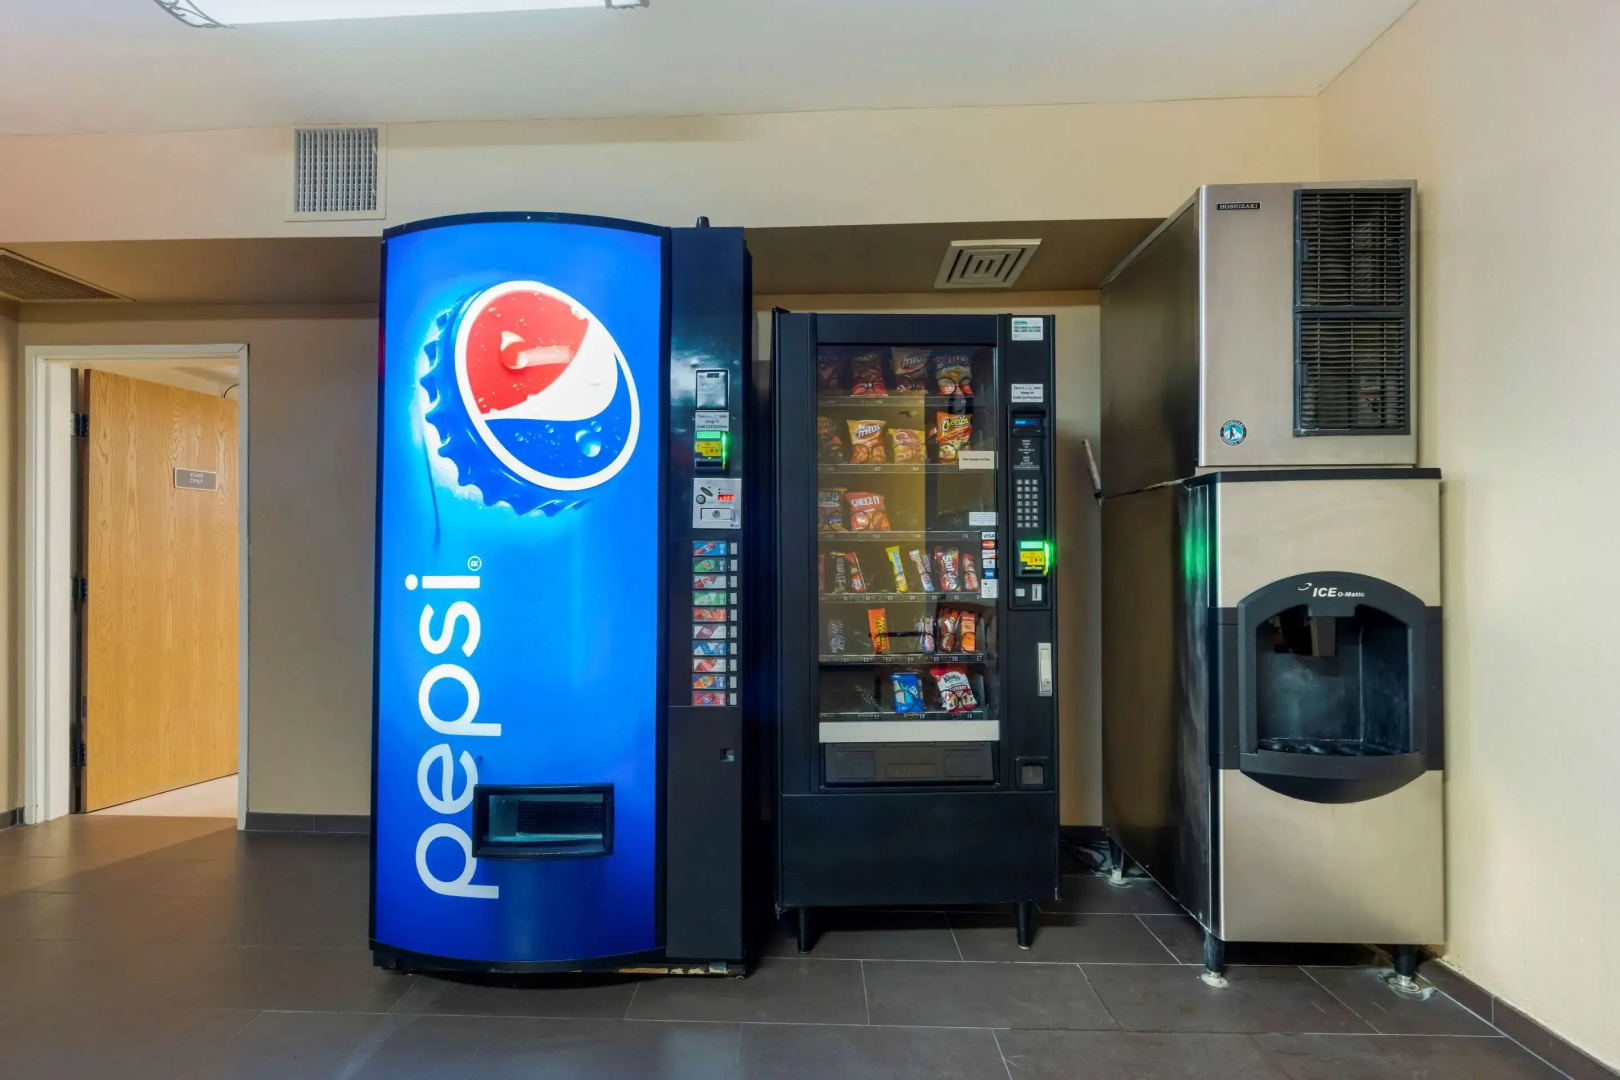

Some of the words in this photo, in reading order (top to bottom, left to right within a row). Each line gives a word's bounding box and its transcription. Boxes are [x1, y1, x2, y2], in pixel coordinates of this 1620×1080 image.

[855, 423, 881, 438] Fritos
[941, 415, 970, 433] Cheetos
[850, 495, 880, 508] CHEEZ-IT
[1312, 587, 1338, 598] ICE
[405, 573, 501, 899] pepsi
